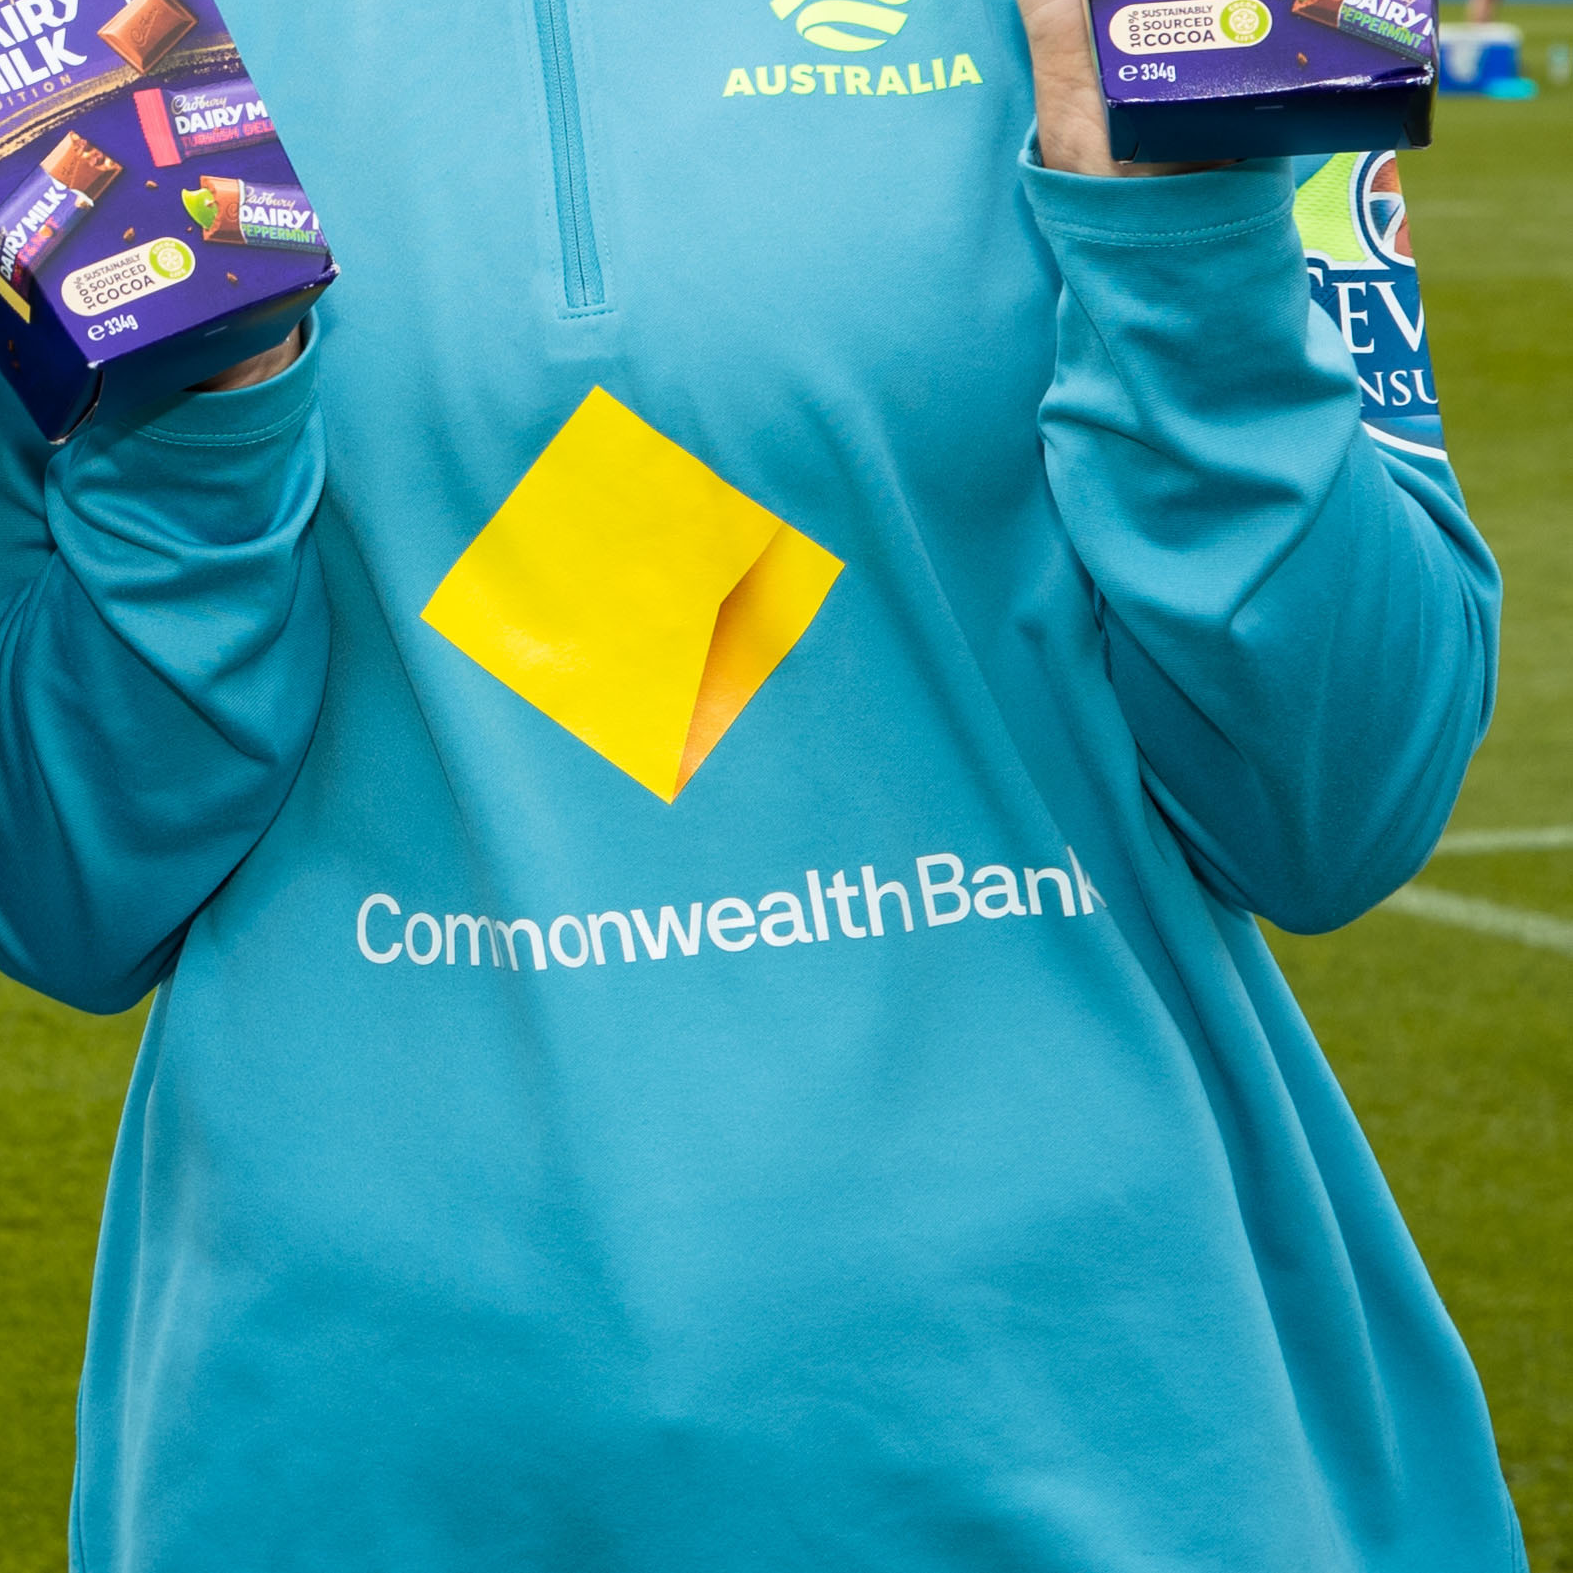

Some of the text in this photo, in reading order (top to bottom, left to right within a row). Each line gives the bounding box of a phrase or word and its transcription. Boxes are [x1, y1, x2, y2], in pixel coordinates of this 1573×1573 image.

[1142, 4, 1213, 18] SUSTAINABLY
[1143, 16, 1214, 31] SOURCED
[1128, 10, 1141, 48] 100%
[1144, 30, 1215, 47] COCOA
[1340, 4, 1425, 49] PEPPERMINT
[722, 53, 984, 98] AUSTRALIA
[1141, 62, 1177, 83] 334g
[171, 94, 227, 115] Cadbury
[174, 103, 243, 136] DAIRY
[21, 185, 68, 232] MILK
[240, 206, 311, 229] DAIRY
[242, 224, 319, 244] PEPPERMINT
[83, 253, 142, 283] SUSTAINABLY
[89, 263, 147, 293] SOURCED
[95, 275, 156, 306] COCOA
[103, 314, 140, 337] 334g
